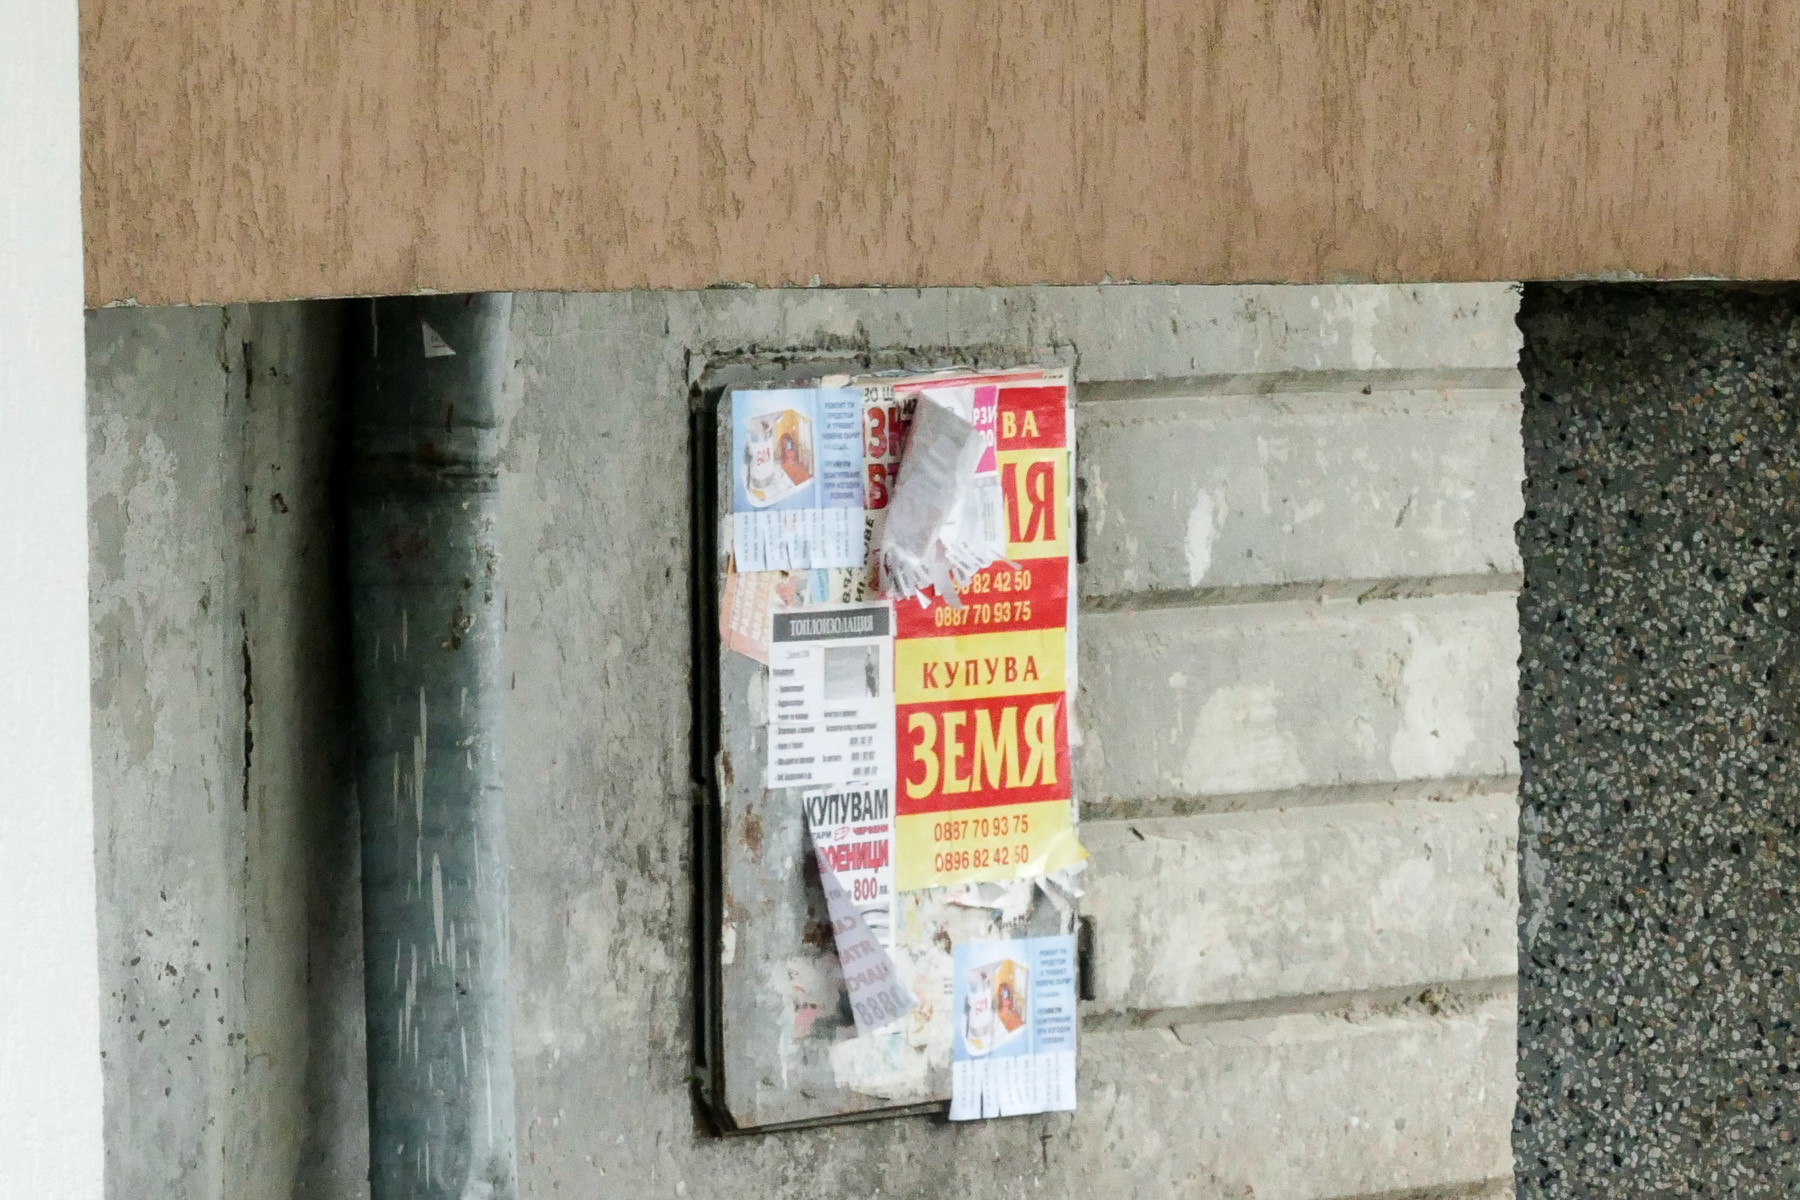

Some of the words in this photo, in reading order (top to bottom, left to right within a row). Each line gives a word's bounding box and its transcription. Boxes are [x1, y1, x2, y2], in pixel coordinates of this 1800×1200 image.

[973, 573, 990, 594] 82
[993, 571, 1012, 592] 42
[1015, 570, 1032, 591] 50
[790, 615, 873, 636] ТОПЛОИЗОЛАЦИЯ
[935, 604, 969, 627] 0887
[973, 604, 991, 624] 70
[994, 602, 1011, 622] 93
[1014, 601, 1032, 621] 75
[923, 655, 1039, 689] КУПУВА
[906, 703, 1057, 799] ЗЕМЯ
[807, 788, 888, 826] КУПУВАМ
[934, 820, 968, 842] 0887
[973, 818, 989, 838] 70
[993, 816, 1009, 836] 93
[1013, 814, 1029, 833] 75
[935, 850, 970, 872] 0896
[973, 848, 989, 868] 82
[993, 846, 1009, 865] 42
[1015, 844, 1029, 864] 50
[854, 877, 878, 901] 800
